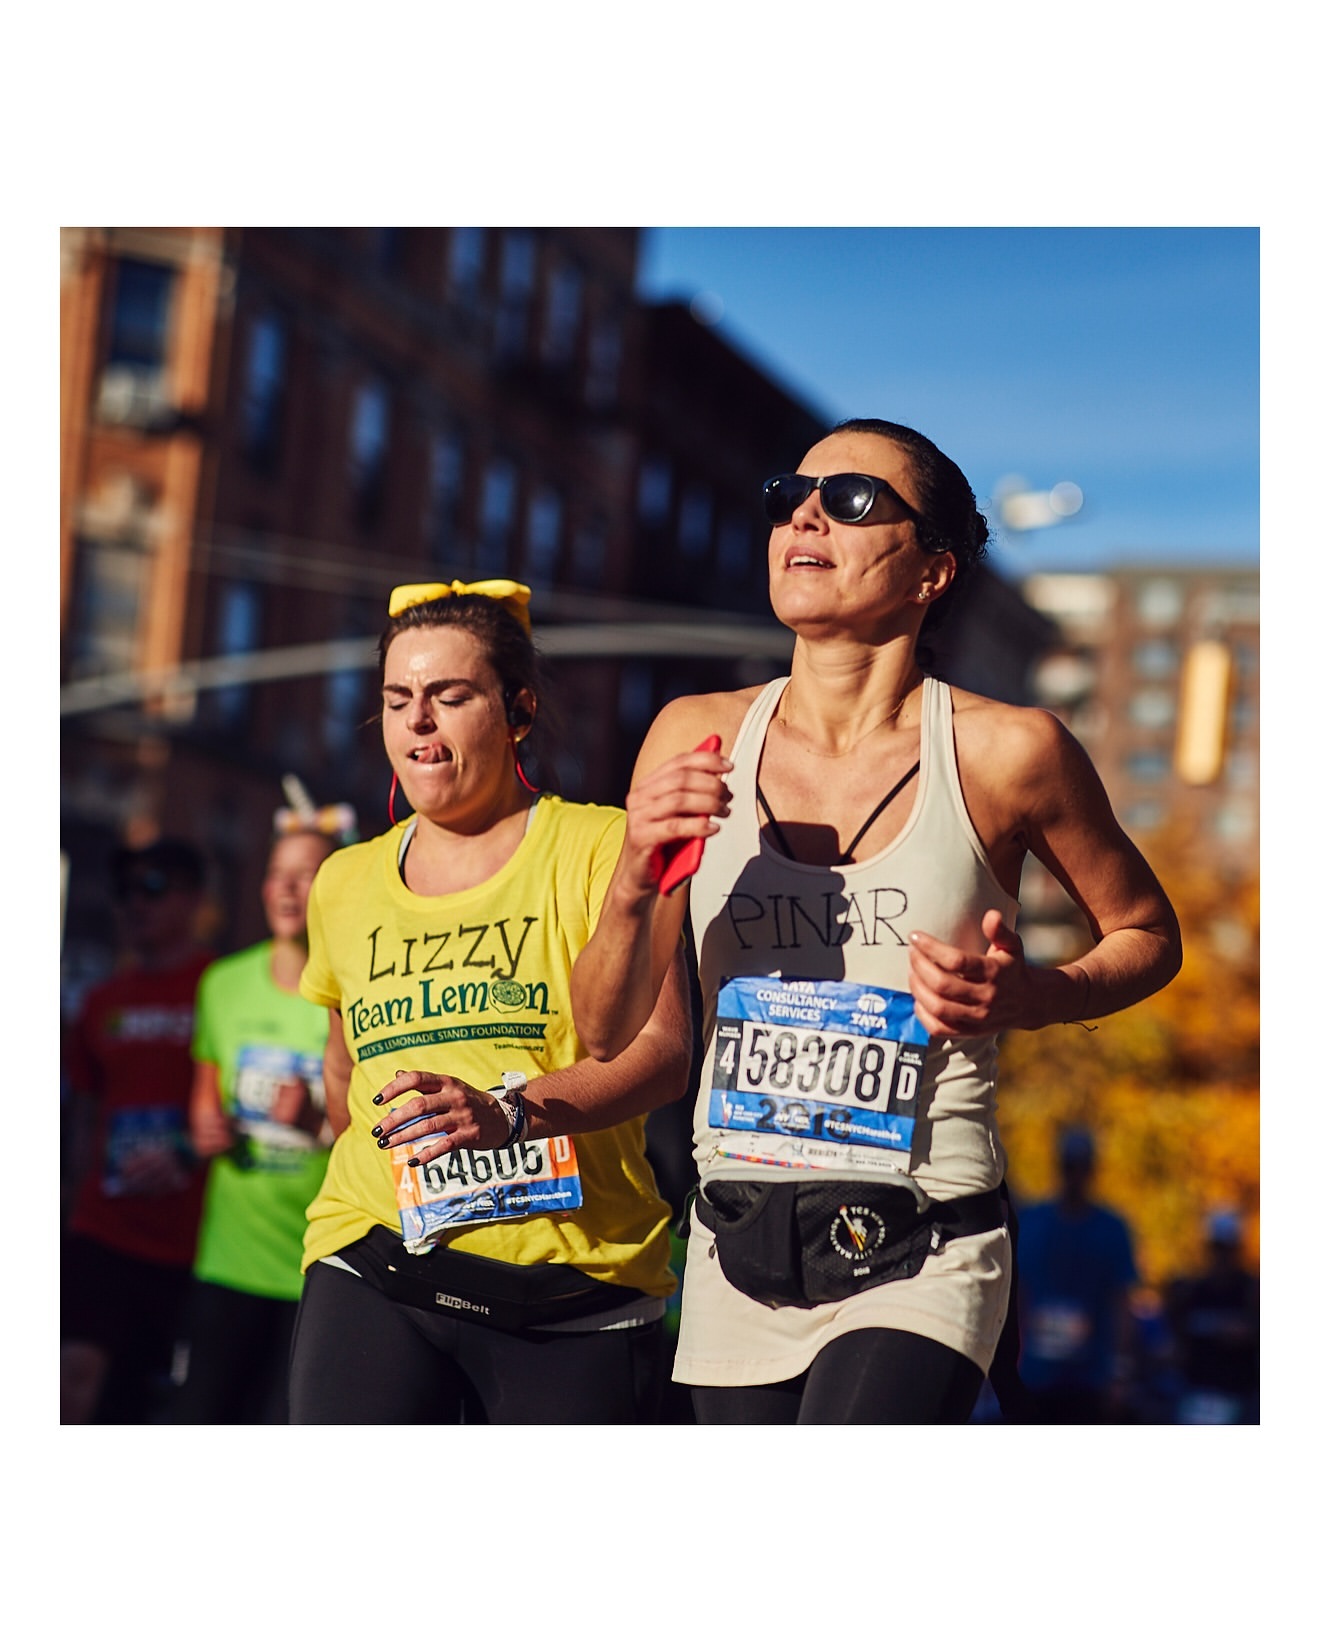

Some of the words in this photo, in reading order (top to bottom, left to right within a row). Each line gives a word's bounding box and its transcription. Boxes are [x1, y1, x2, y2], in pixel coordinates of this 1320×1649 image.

[722, 887, 909, 950] PINAR
[756, 988, 838, 1011] CONSULTANCY
[768, 1003, 821, 1022] SERVICES
[347, 993, 414, 1040] Team
[850, 1012, 888, 1030] TATA
[359, 1042, 384, 1059] ALEX'S
[384, 1031, 435, 1051] LEMONADE
[437, 1027, 469, 1041] STAND
[470, 1025, 541, 1038] FOUNDATION
[719, 1040, 735, 1074] 4
[746, 1027, 886, 1102] 58308
[896, 1064, 918, 1100] D
[554, 1135, 570, 1163] D
[400, 1163, 414, 1194] 4
[436, 1292, 490, 1315] FlipBelt
